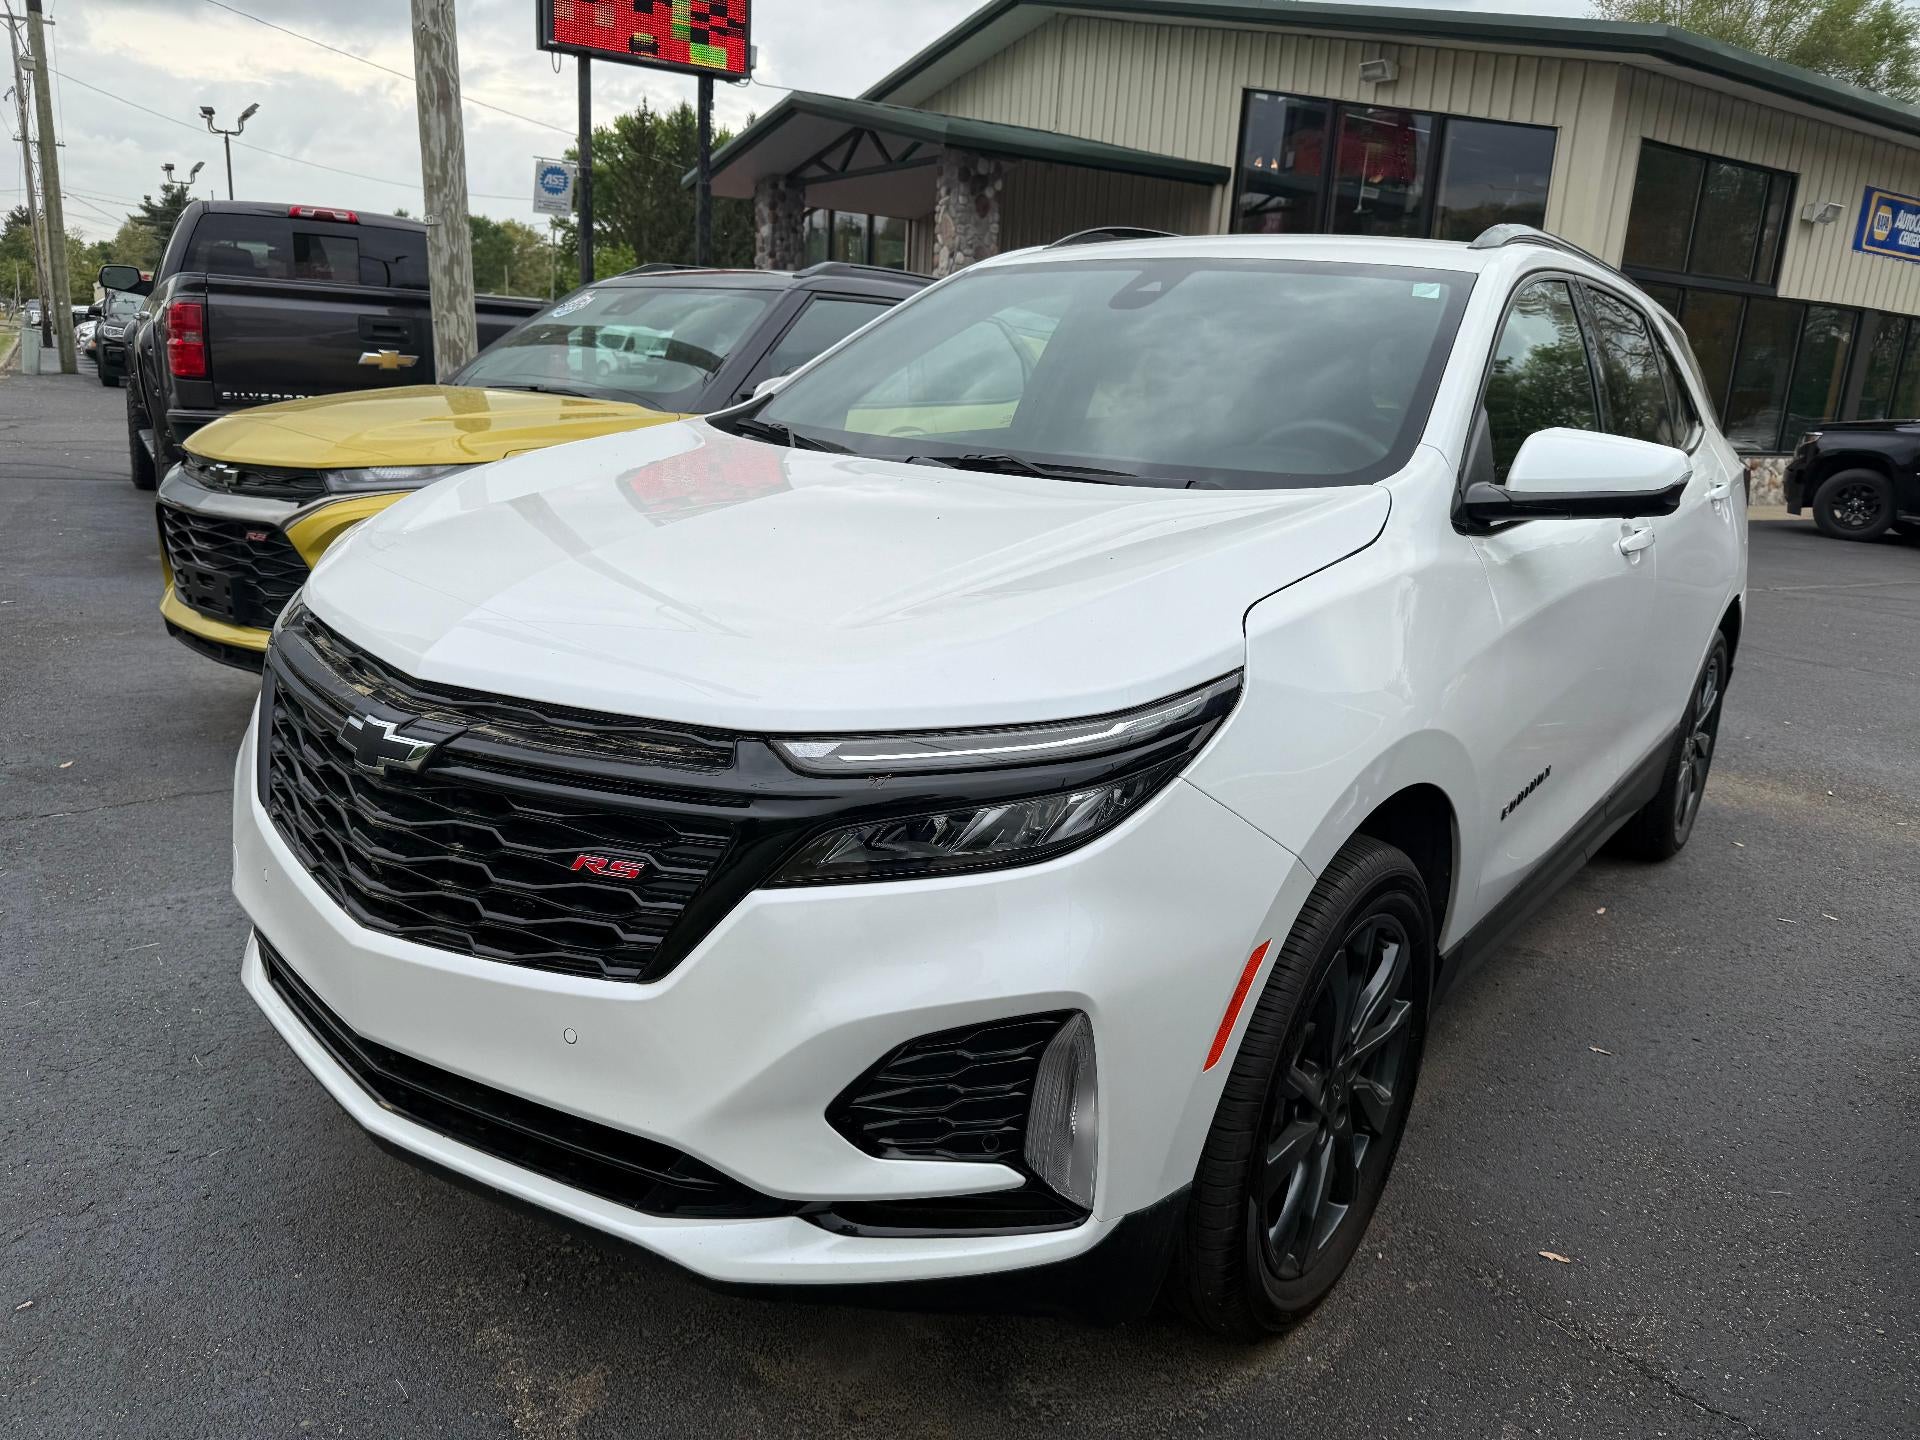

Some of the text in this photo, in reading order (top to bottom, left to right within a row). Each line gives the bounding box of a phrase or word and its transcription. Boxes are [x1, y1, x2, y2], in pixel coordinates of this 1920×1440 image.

[544, 174, 564, 186] ASE
[245, 532, 267, 541] RS
[1500, 764, 1551, 821] EQUINOX
[570, 855, 645, 879] RS
